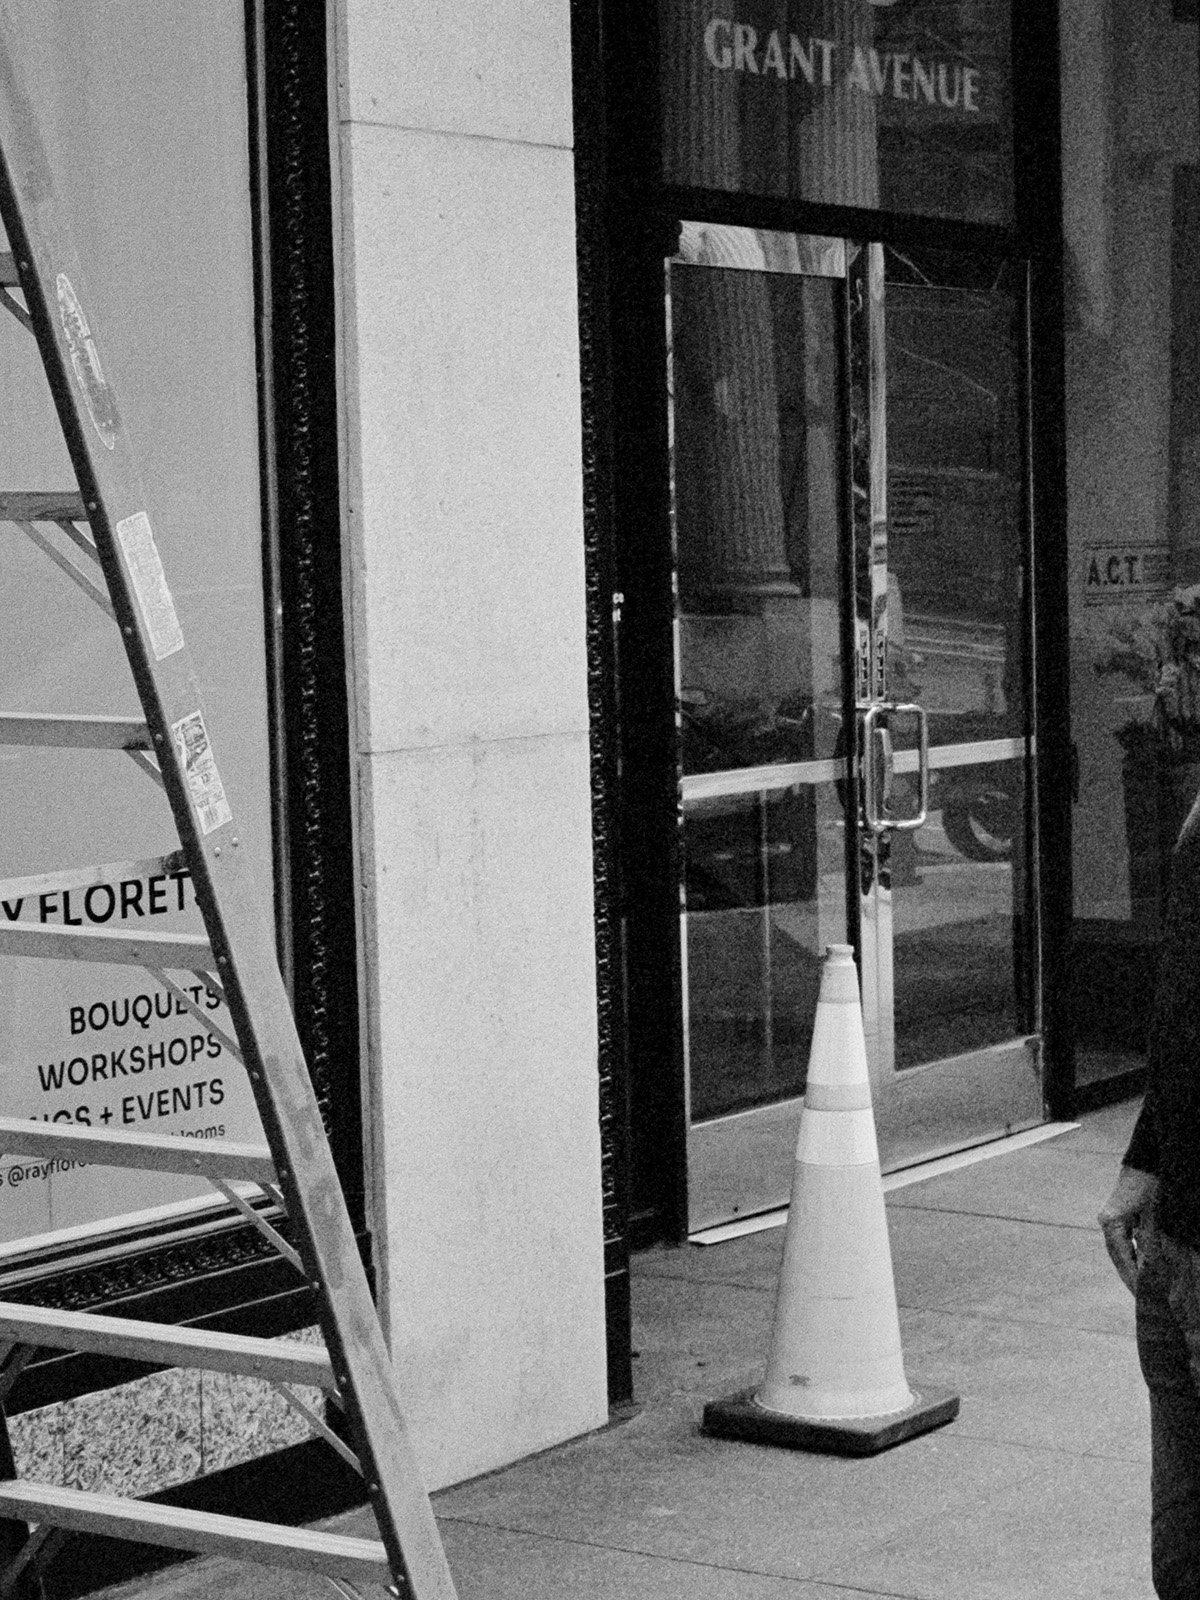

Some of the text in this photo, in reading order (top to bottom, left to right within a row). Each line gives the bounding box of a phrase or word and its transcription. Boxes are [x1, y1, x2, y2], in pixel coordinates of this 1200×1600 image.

[703, 18, 980, 112] GRANT AVENUE
[40, 870, 199, 926] FLORET
[38, 1033, 222, 1092] WORKSHOPS
[122, 1078, 225, 1124] EVENTS
